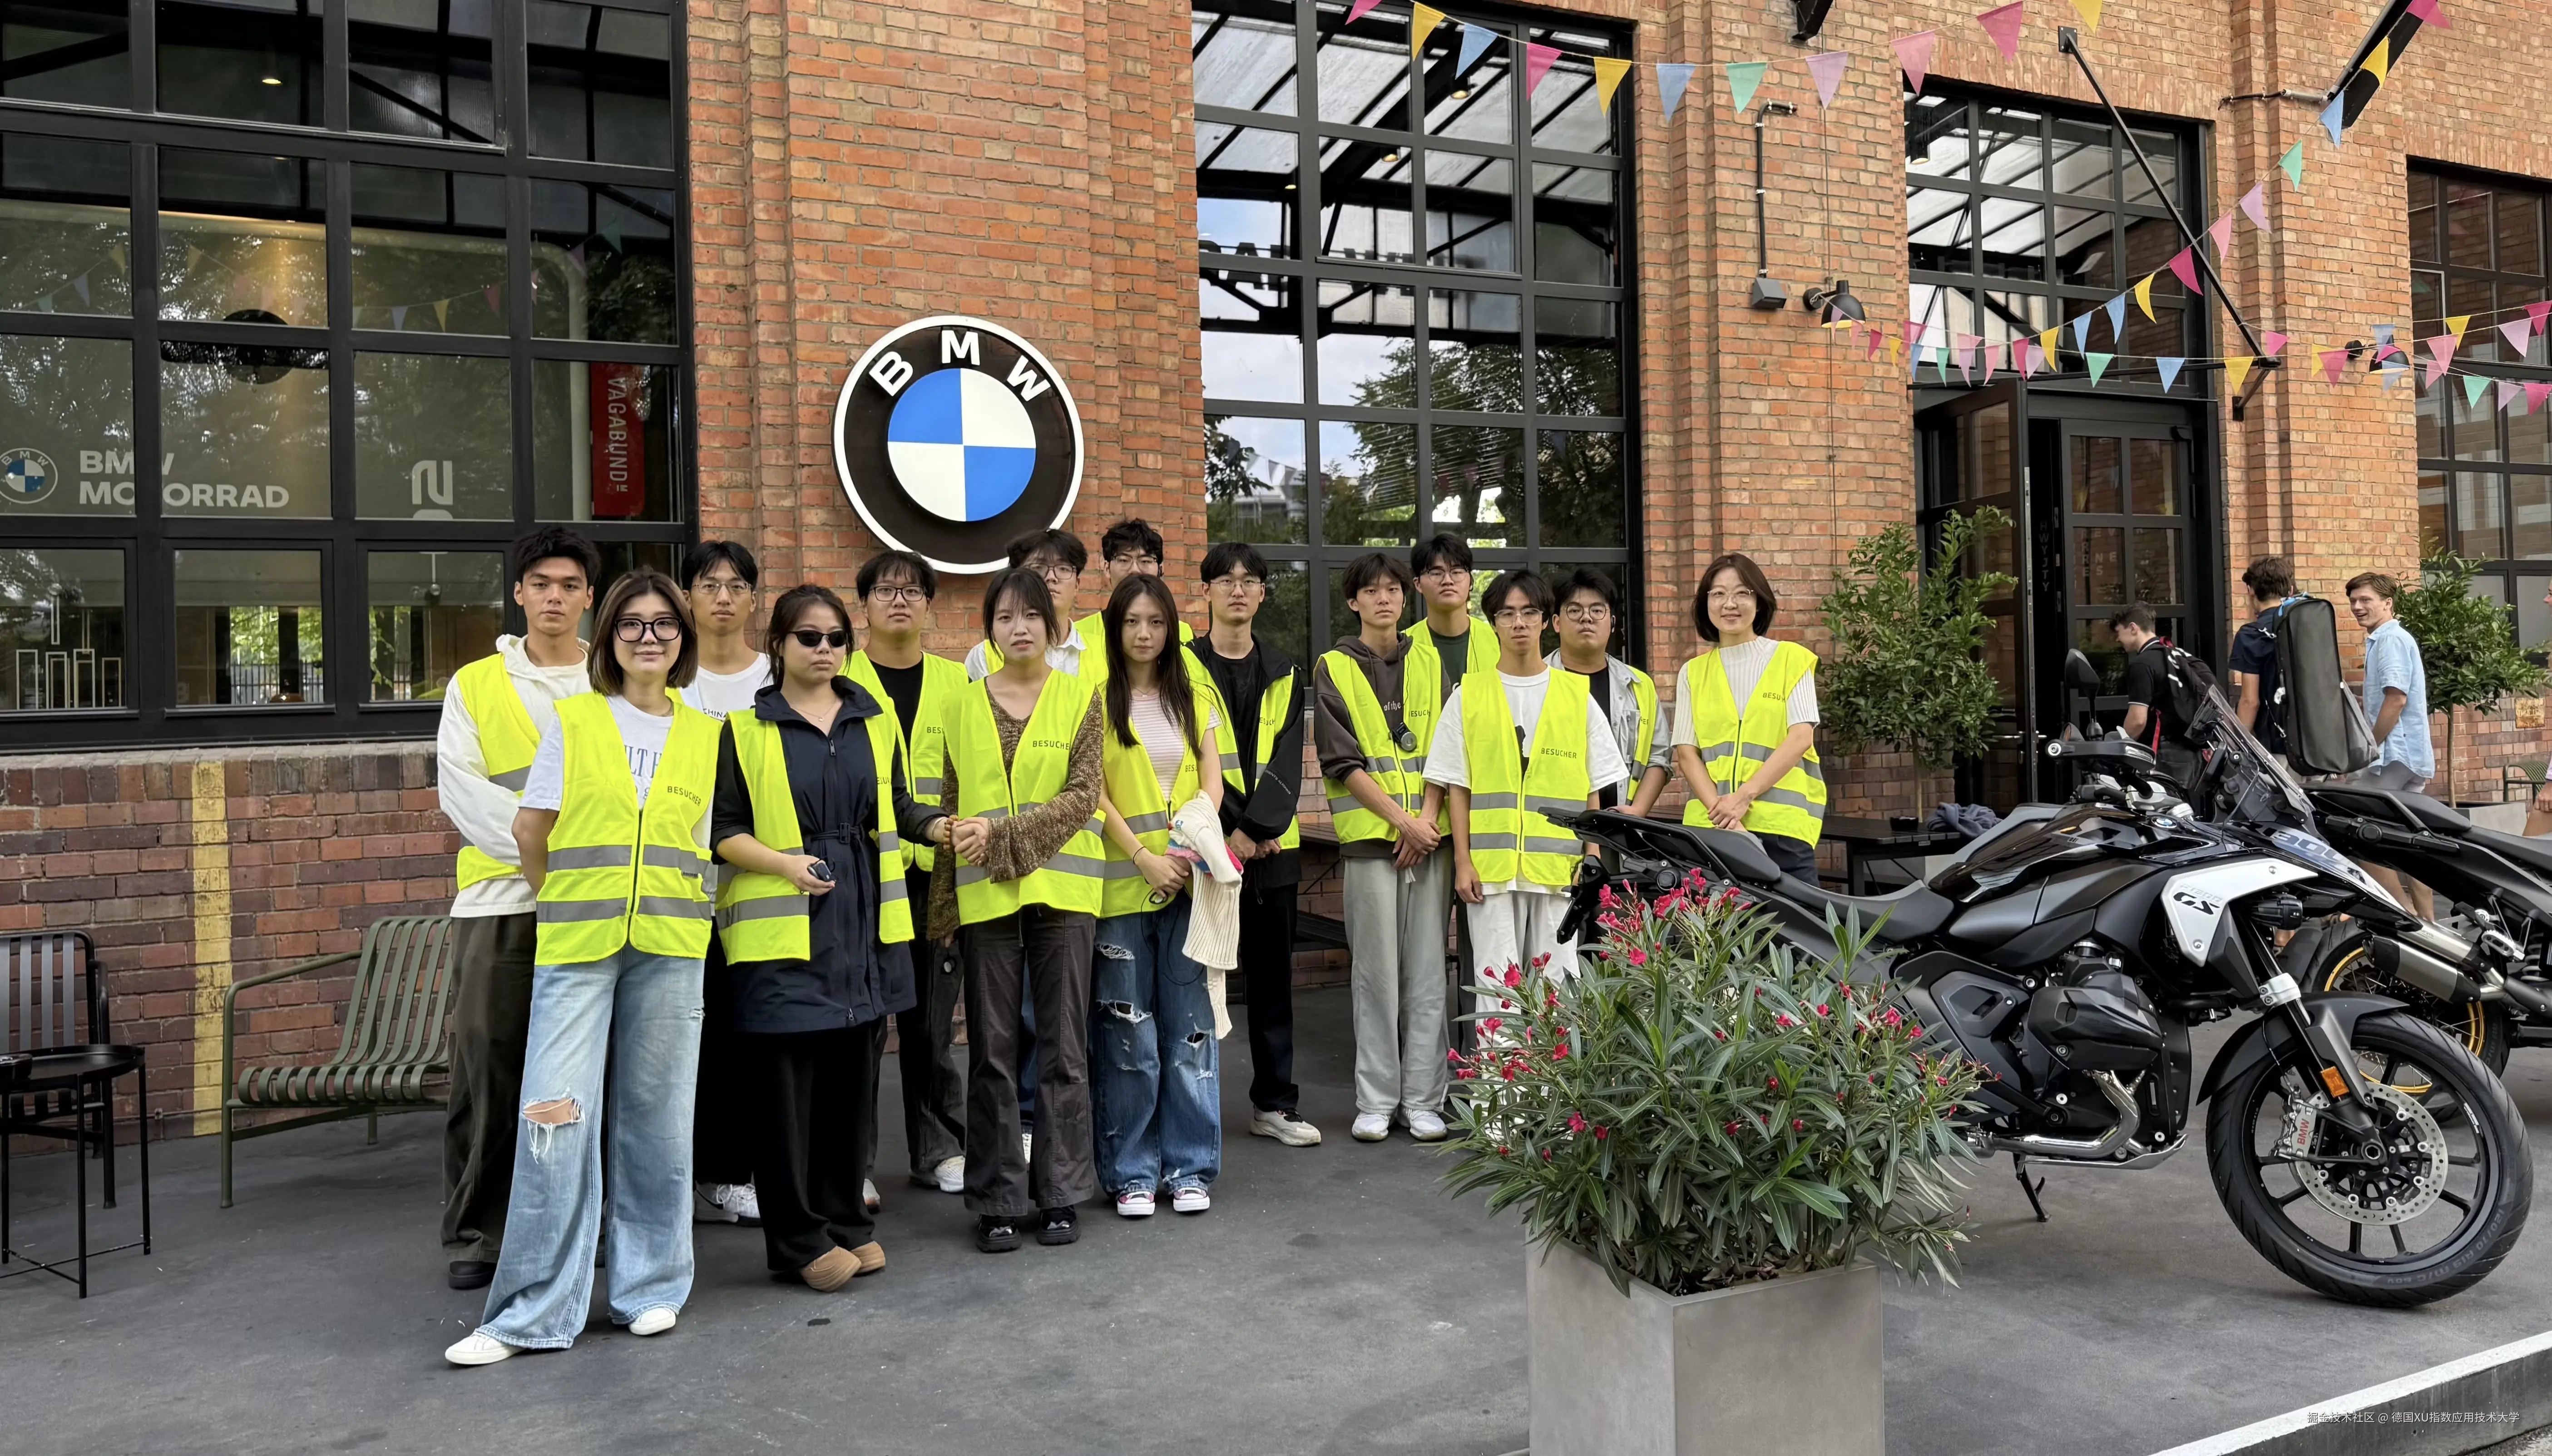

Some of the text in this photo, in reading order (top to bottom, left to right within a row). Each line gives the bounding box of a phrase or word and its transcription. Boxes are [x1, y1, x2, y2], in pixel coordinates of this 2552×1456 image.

[868, 330, 1051, 402] BMW
[608, 377, 628, 482] VAGABUND
[79, 481, 290, 508] MOORRAD
[1541, 747, 1577, 759] BESUCHER
[667, 786, 702, 806] BESUCHER
[2173, 891, 2221, 915] GS
[2297, 1118, 2310, 1145] BMW
